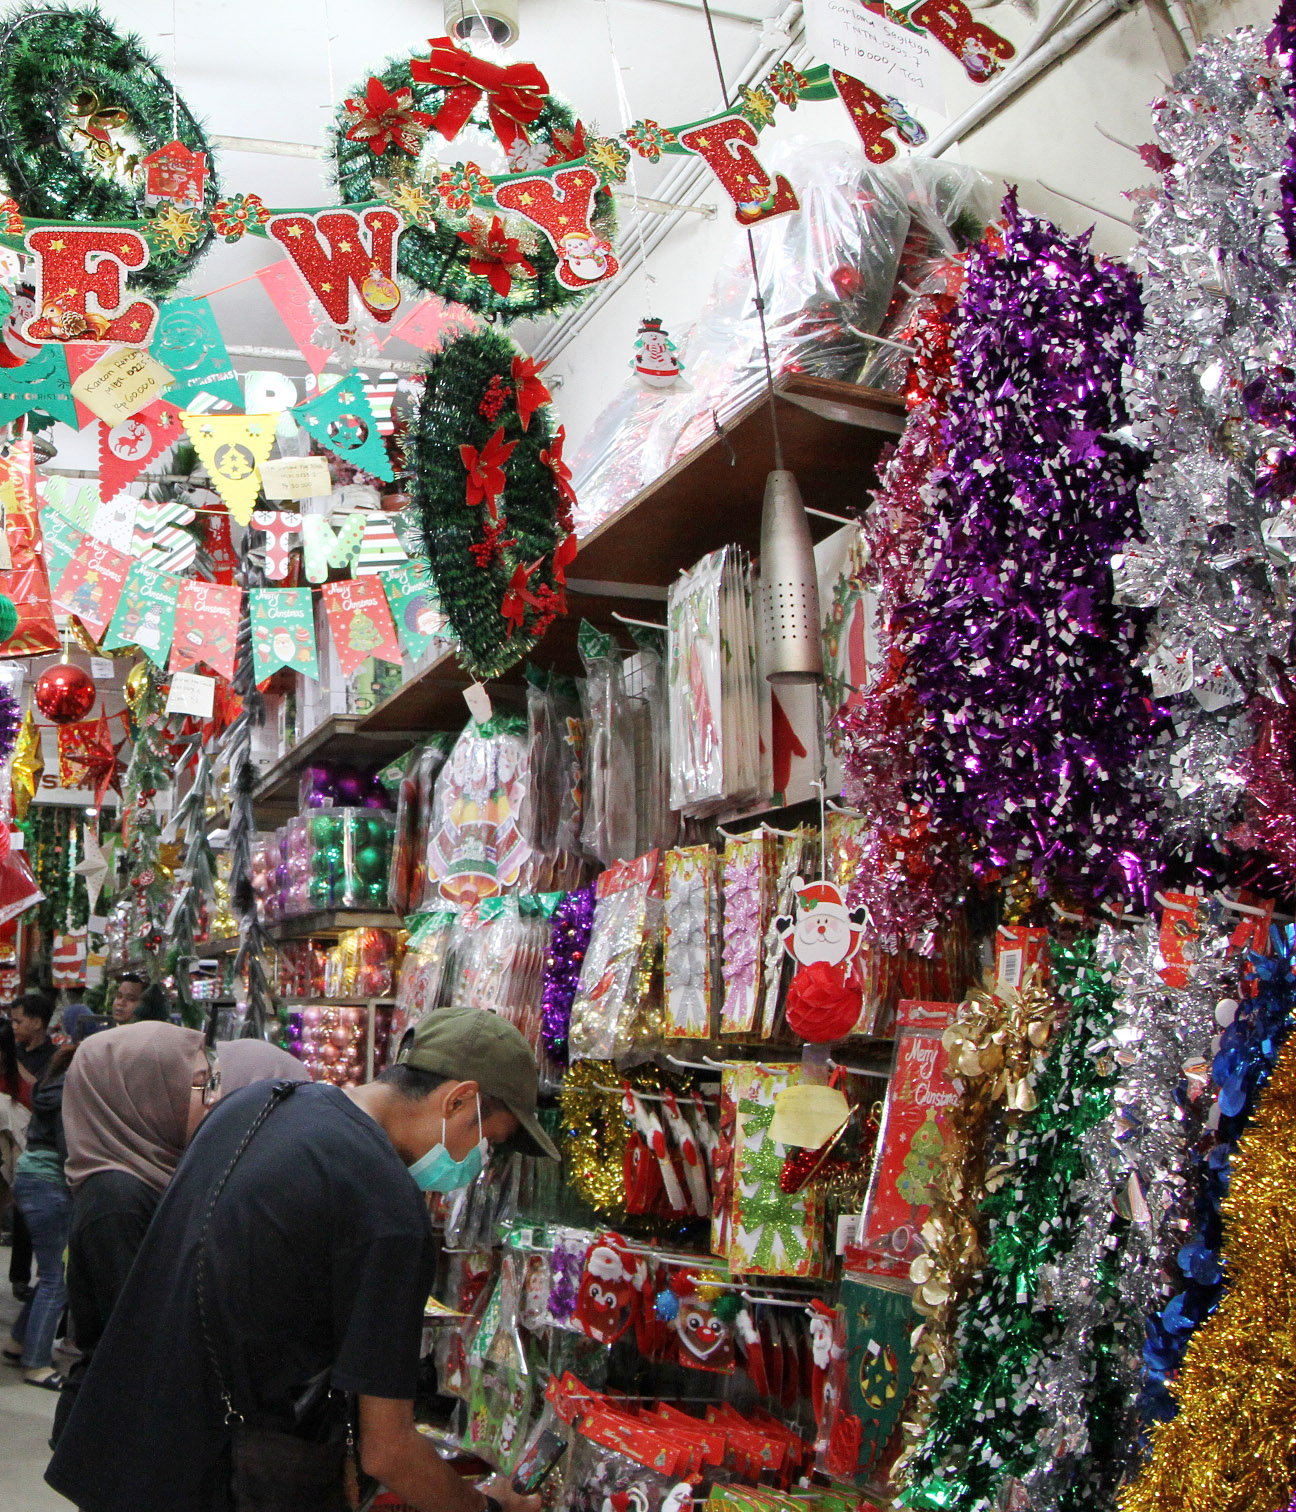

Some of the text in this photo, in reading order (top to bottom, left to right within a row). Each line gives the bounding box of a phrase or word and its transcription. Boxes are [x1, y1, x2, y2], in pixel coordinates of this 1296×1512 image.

[492, 0, 1017, 290] YEAR
[255, 589, 280, 608] Merry
[327, 582, 351, 601] Merry
[267, 607, 305, 619] Christmas
[342, 597, 378, 612] Christmas
[905, 1038, 939, 1079] Merry
[915, 1083, 960, 1108] Christma
